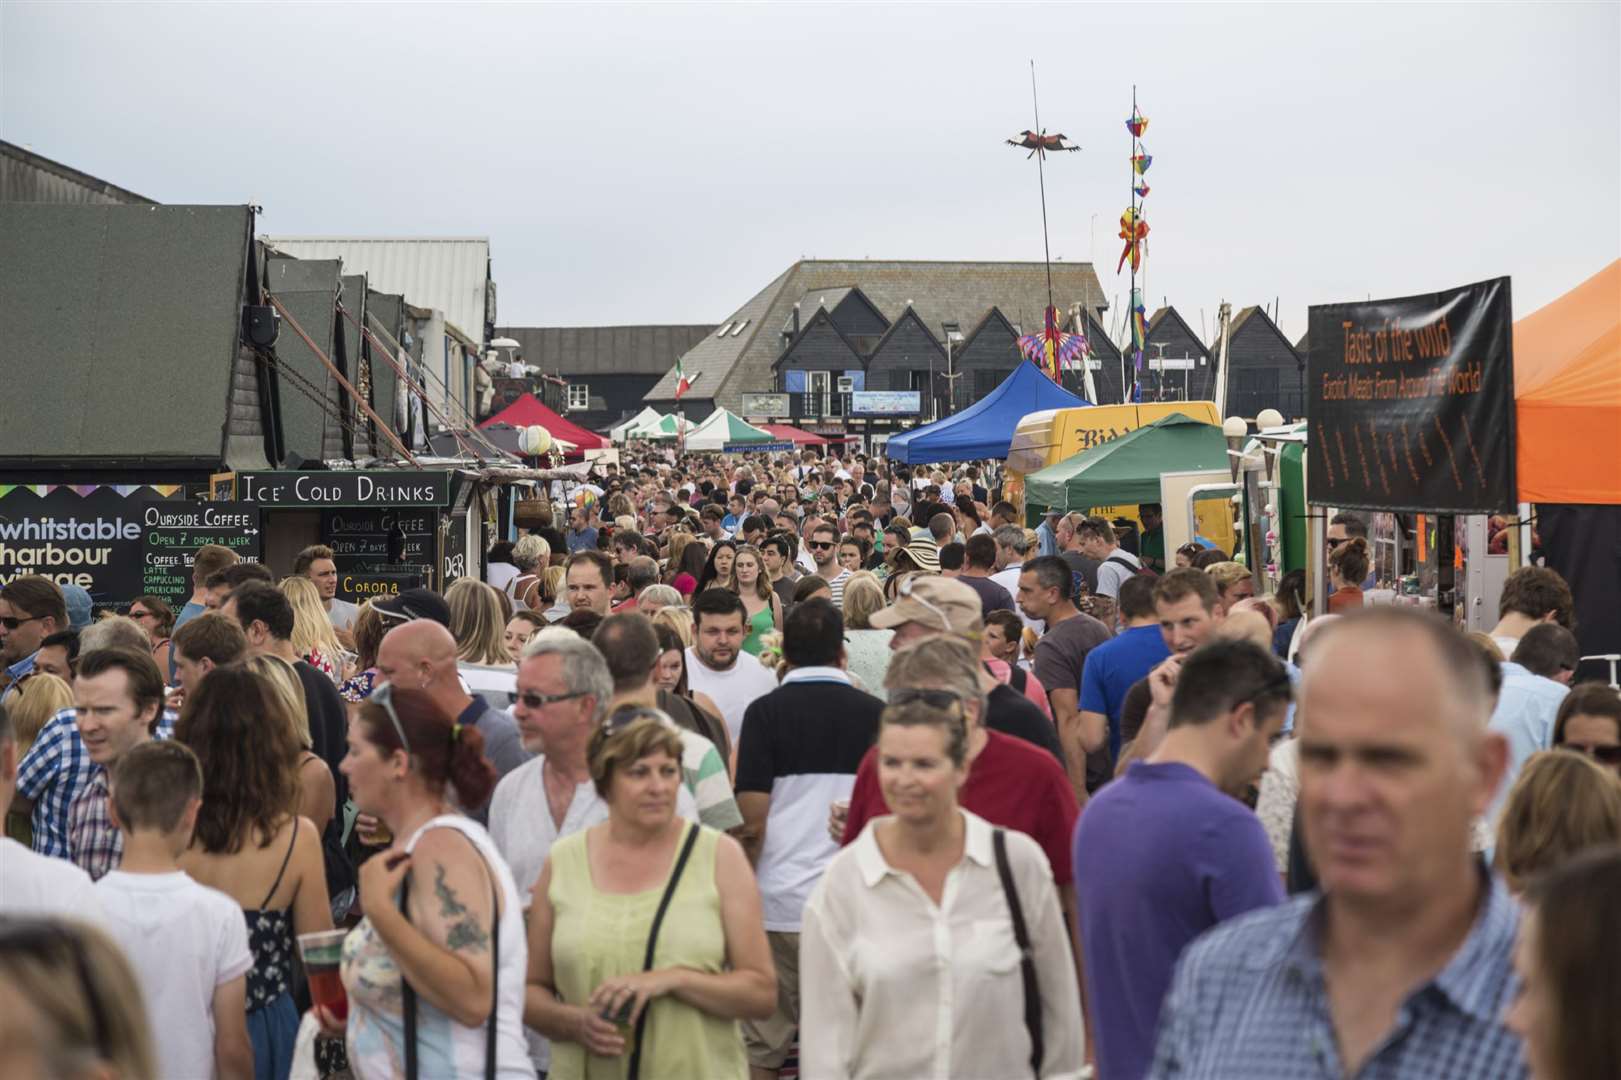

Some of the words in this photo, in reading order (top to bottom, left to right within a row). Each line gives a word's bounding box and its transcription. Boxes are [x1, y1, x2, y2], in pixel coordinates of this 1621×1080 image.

[1343, 321, 1372, 364] Taste
[1375, 318, 1388, 363] of
[1391, 316, 1413, 361] the
[1322, 372, 1346, 400] Exotic
[1347, 372, 1372, 400] Meats
[1375, 371, 1396, 400] From
[1447, 361, 1481, 395] World
[295, 475, 342, 502] COLD
[357, 475, 434, 502] DRINKS
[0, 517, 141, 540] whitstable
[149, 532, 175, 546] OPEN
[180, 532, 187, 545] 7
[193, 537, 214, 545] DAYS
[228, 537, 250, 546] WEEK
[0, 542, 112, 565] harbour
[144, 567, 168, 575] LATTE
[144, 576, 185, 584] CAPPUCCINO
[144, 586, 185, 594] AMERICANO
